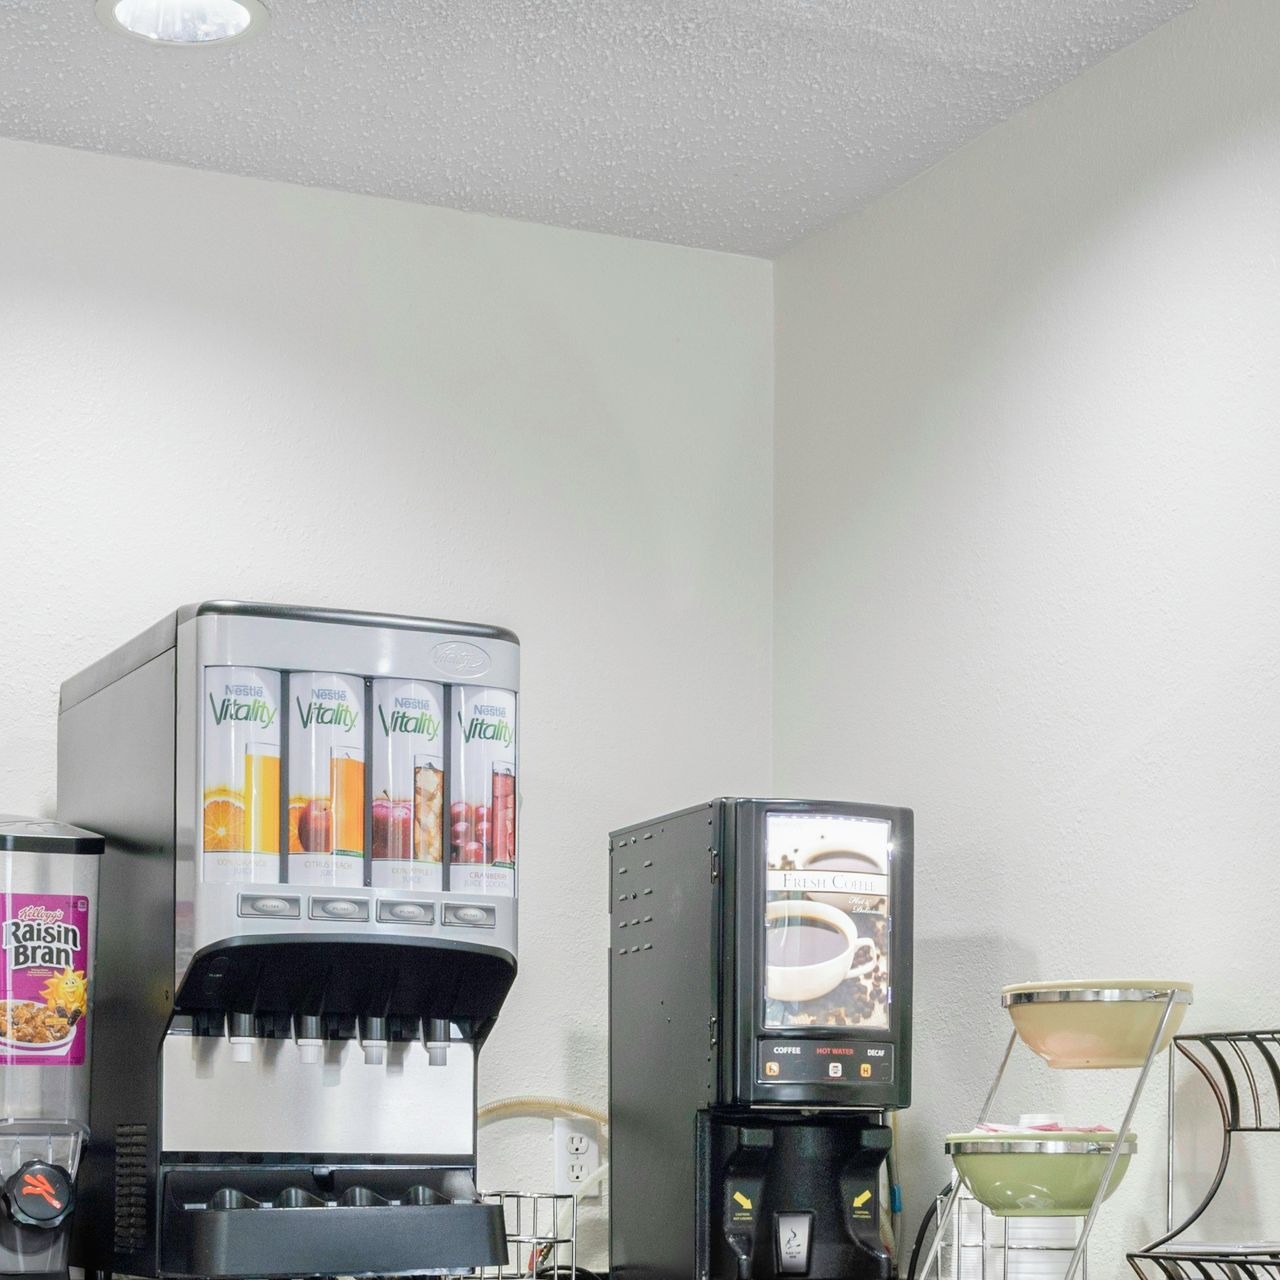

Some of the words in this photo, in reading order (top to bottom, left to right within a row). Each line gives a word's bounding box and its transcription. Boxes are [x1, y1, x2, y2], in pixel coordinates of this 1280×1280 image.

[208, 691, 278, 730] Vitality
[296, 695, 359, 733] Vitality
[378, 703, 441, 742] Vitality
[458, 710, 515, 749] Vitality
[783, 873, 826, 889] FRESH
[18, 905, 64, 922] Kellogg's
[4, 920, 80, 949] Raisin
[12, 943, 73, 969] Bran
[816, 1047, 831, 1055] HOT
[832, 1048, 854, 1056] WATER
[867, 1049, 885, 1057] DECAF
